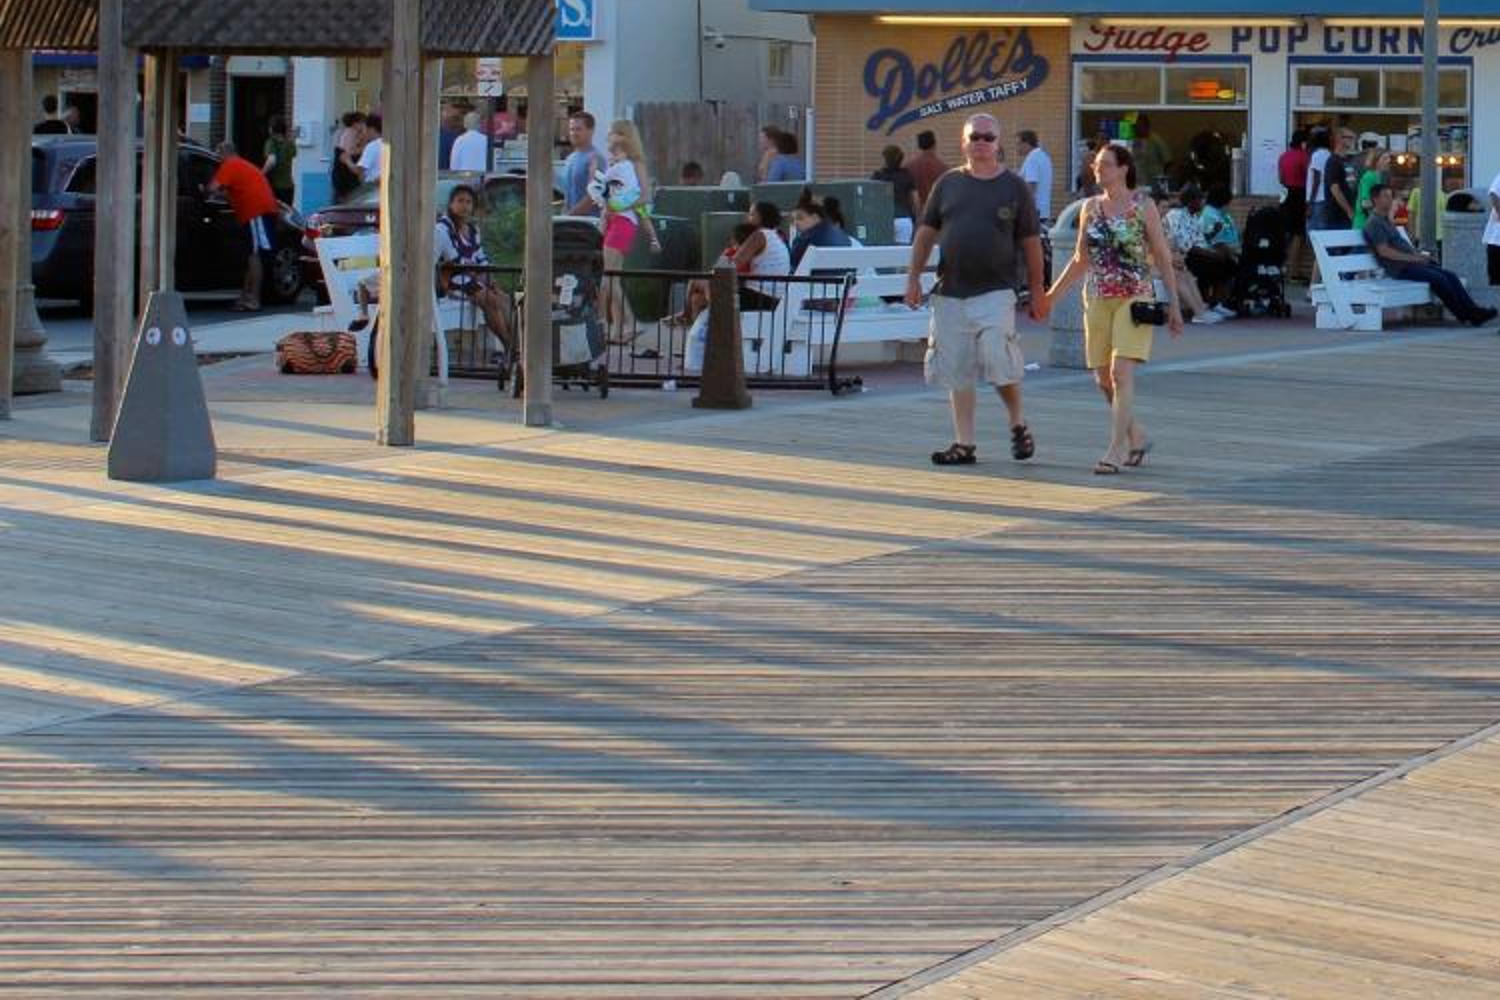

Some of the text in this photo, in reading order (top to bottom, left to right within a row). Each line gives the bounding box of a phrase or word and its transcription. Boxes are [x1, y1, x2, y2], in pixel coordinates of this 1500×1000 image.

[1083, 24, 1211, 63] Fudge
[1231, 23, 1309, 54] POP
[1323, 25, 1425, 54] CORN
[919, 77, 1028, 118] SALT WATER TAFFY
